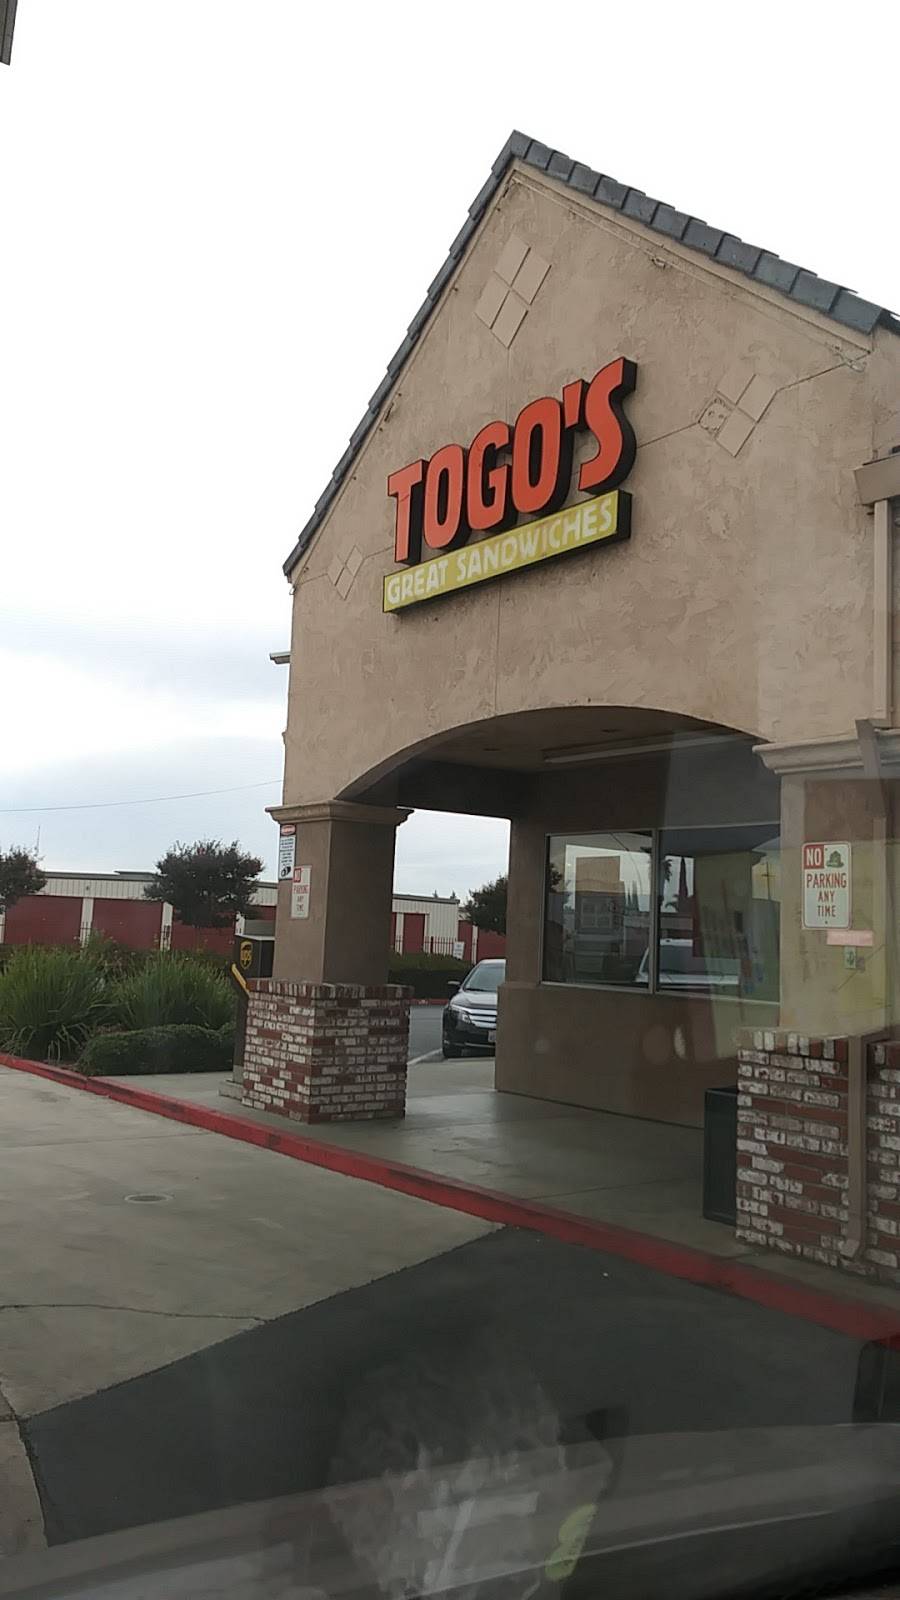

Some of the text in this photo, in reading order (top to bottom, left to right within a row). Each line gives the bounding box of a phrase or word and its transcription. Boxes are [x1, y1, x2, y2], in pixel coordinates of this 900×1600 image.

[387, 356, 633, 564] TOGO'S
[387, 499, 612, 604] GREAT SANDWICHES
[806, 848, 822, 866] NO
[806, 872, 847, 889] PARKING
[818, 891, 835, 902] ANY
[817, 905, 836, 917] TIME
